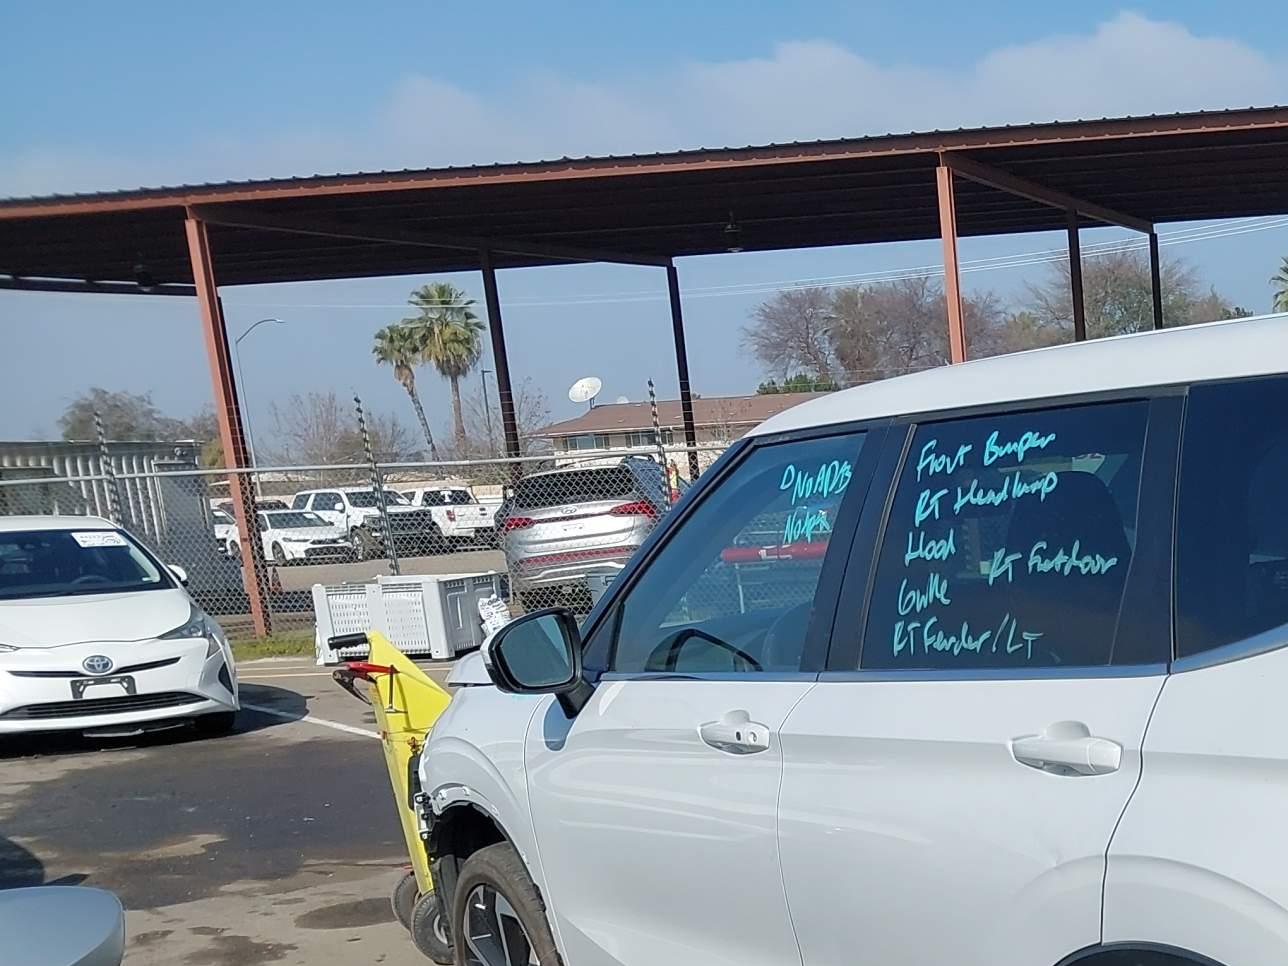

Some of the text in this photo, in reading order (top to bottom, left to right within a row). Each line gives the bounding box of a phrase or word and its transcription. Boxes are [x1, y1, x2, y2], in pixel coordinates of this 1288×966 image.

[917, 430, 1056, 482] Front Bumper
[915, 488, 948, 527] RT
[905, 528, 956, 567] Hood
[989, 547, 1022, 586] RT
[894, 620, 920, 657] RT
